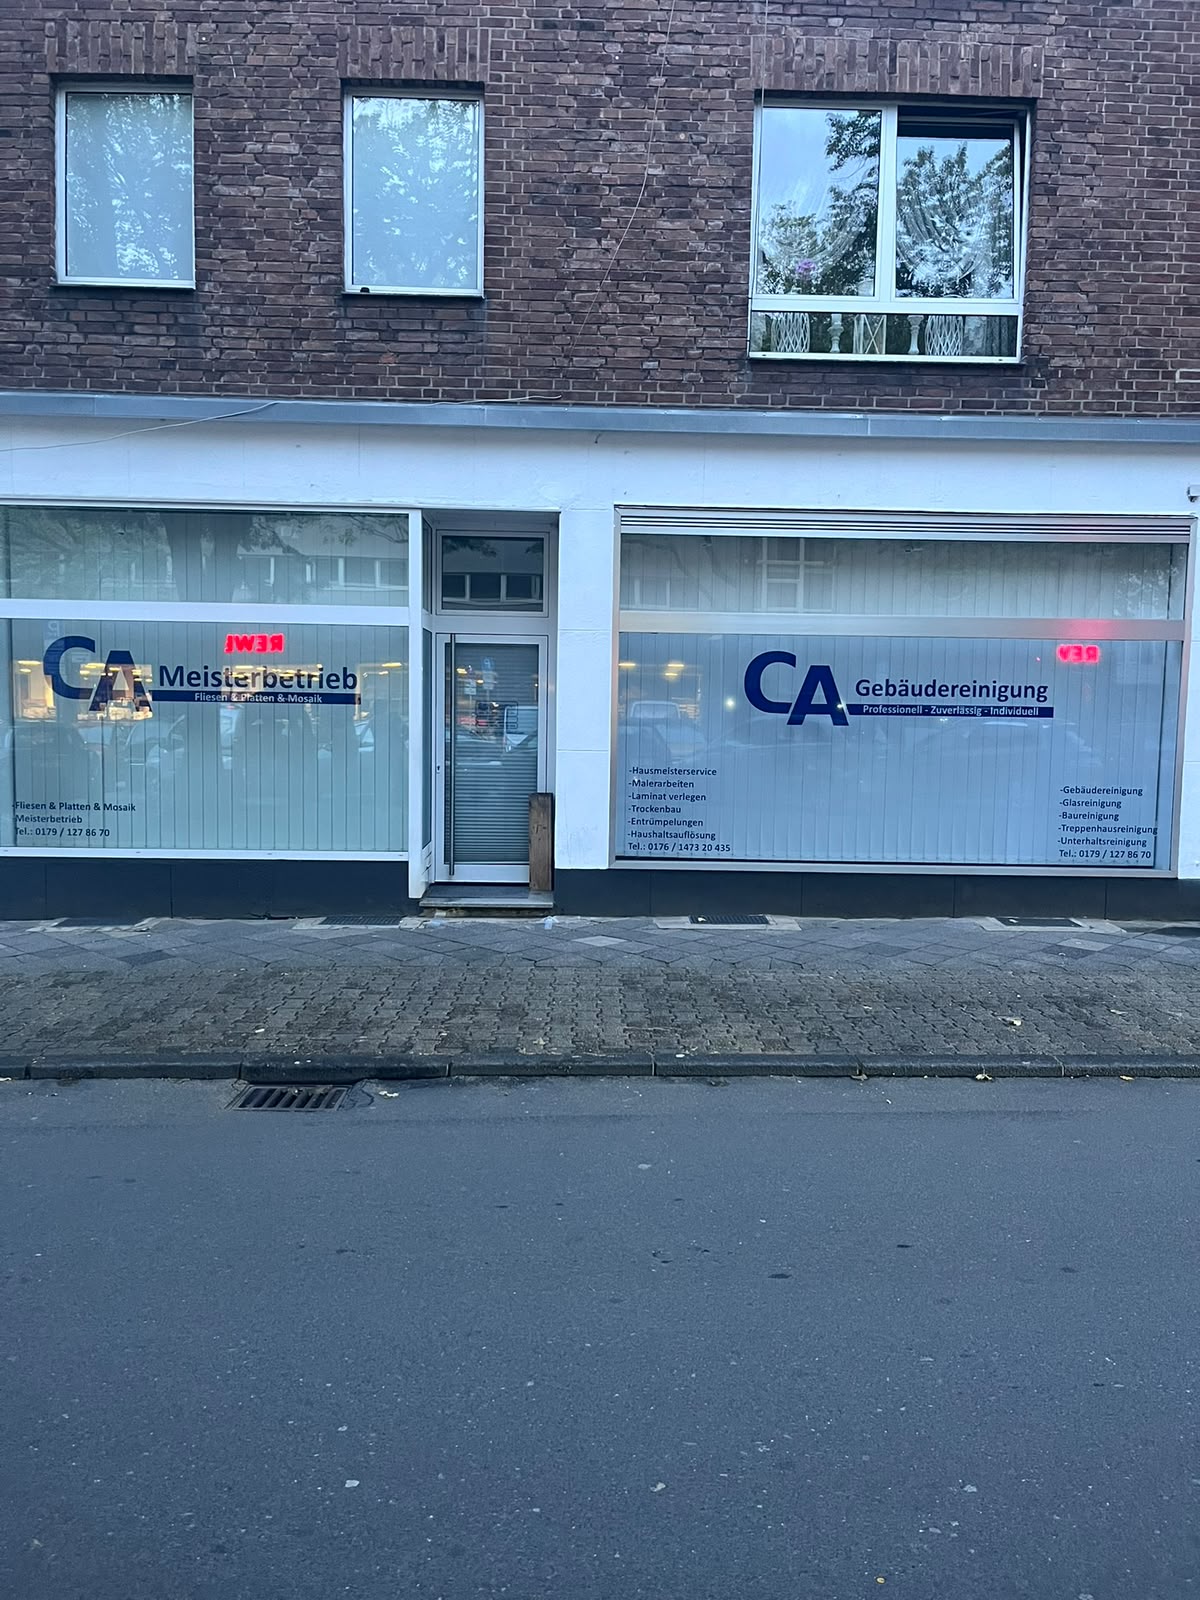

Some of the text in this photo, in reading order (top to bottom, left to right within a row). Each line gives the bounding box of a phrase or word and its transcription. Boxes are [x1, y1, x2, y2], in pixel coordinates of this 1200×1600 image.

[43, 636, 152, 711] CA
[159, 665, 358, 690] Meisterbetrieb
[744, 650, 849, 726] CA
[855, 679, 1048, 702] Gebäudereinigung
[194, 692, 322, 703] Fliesen & Platten & Mosaik
[862, 705, 922, 714] Professionell
[930, 706, 982, 716] Zuverlässig
[990, 706, 1038, 716] Individuell
[628, 766, 717, 776] -Hausmeisterservice
[628, 779, 694, 788] -Malerarbeiten
[1060, 786, 1143, 796] -Gebäudereinigung
[628, 792, 706, 802] -Laminat verlegen
[48, 802, 56, 810] &
[59, 802, 90, 810] Platten
[94, 802, 101, 810] &
[103, 803, 136, 812] Mosaik
[628, 804, 682, 813] -Trockenbau
[1060, 799, 1122, 808] -Glasreinigung
[1058, 812, 1120, 821] -Baureinigung
[628, 818, 704, 828] -Entrümpelungen
[35, 828, 58, 836] 0179
[60, 828, 65, 838] /
[67, 828, 83, 836] 127
[86, 829, 96, 837] 86
[99, 829, 110, 837] 70
[1058, 824, 1158, 835] -Treppenhausreinigung
[627, 830, 716, 841] -Haushaltsauflösung
[628, 842, 731, 852] Tel.: 0176 / 1473 20 435
[1058, 837, 1147, 848] -Unterhaltsreinigung
[1059, 850, 1076, 858] Tel.:
[1079, 850, 1100, 858] 0179
[1102, 850, 1108, 859] /
[1110, 850, 1126, 858] 127
[1140, 851, 1152, 859] 70
